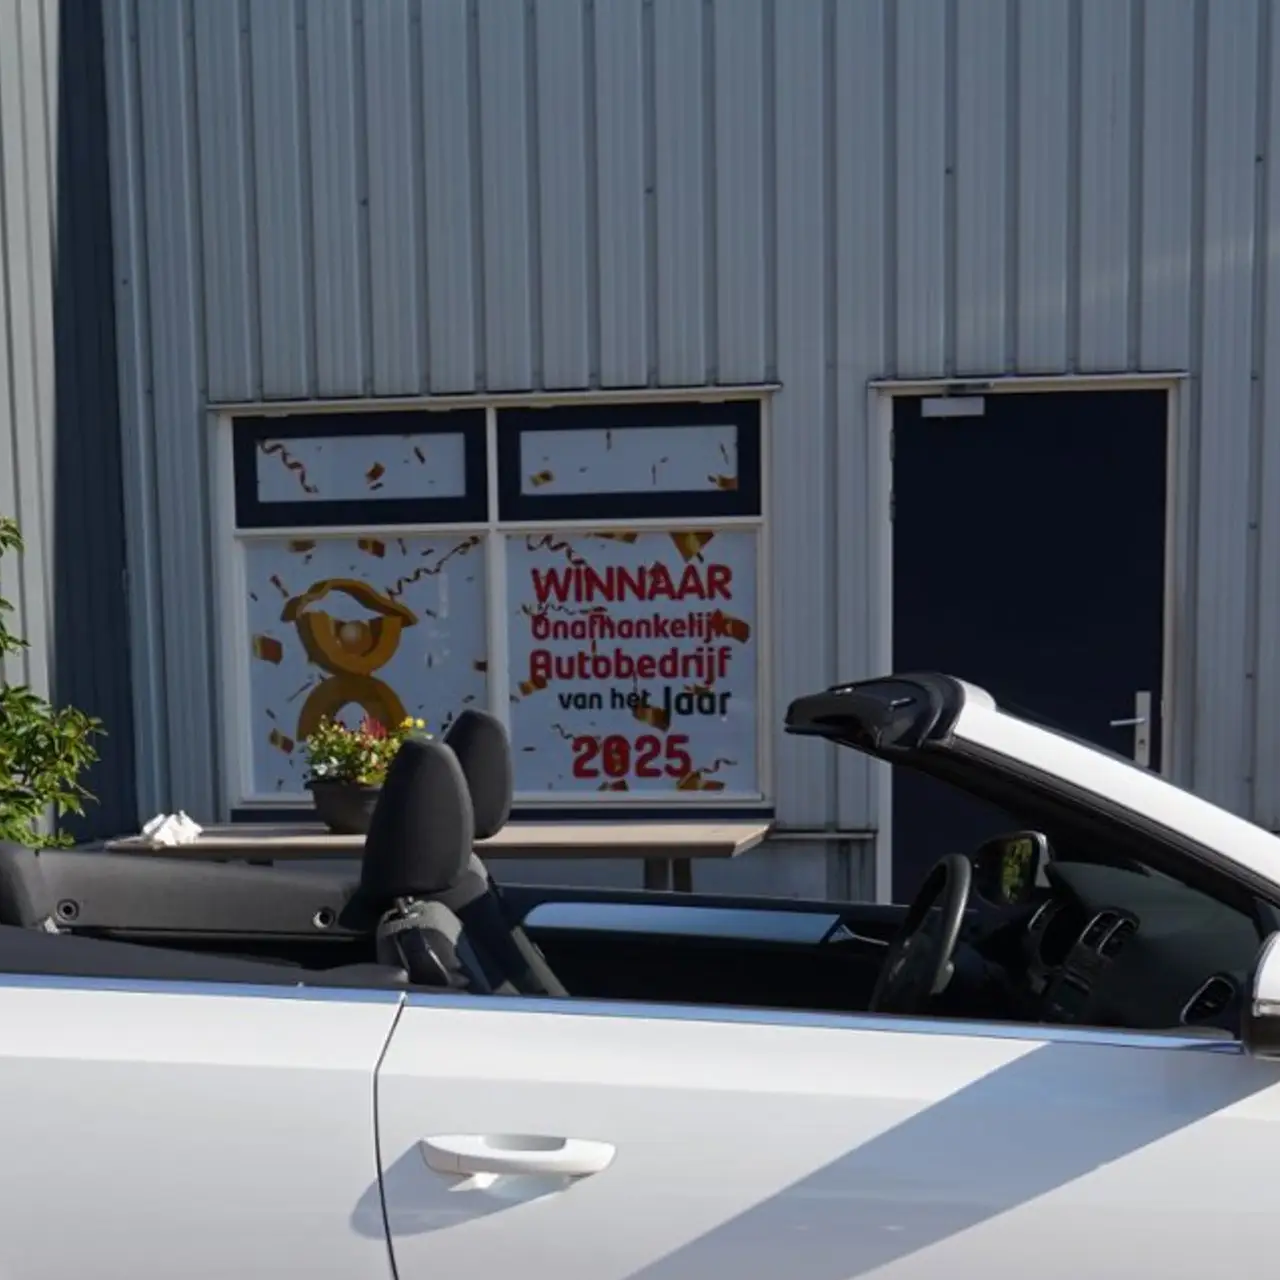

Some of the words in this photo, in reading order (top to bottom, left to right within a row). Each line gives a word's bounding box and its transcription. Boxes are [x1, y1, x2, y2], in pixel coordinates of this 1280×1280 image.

[531, 564, 732, 603] WINNAAR
[529, 646, 732, 685] Autobedrijf
[558, 690, 603, 710] van
[610, 687, 652, 710] het
[658, 686, 732, 725] Jaar
[572, 734, 692, 779] 2025
